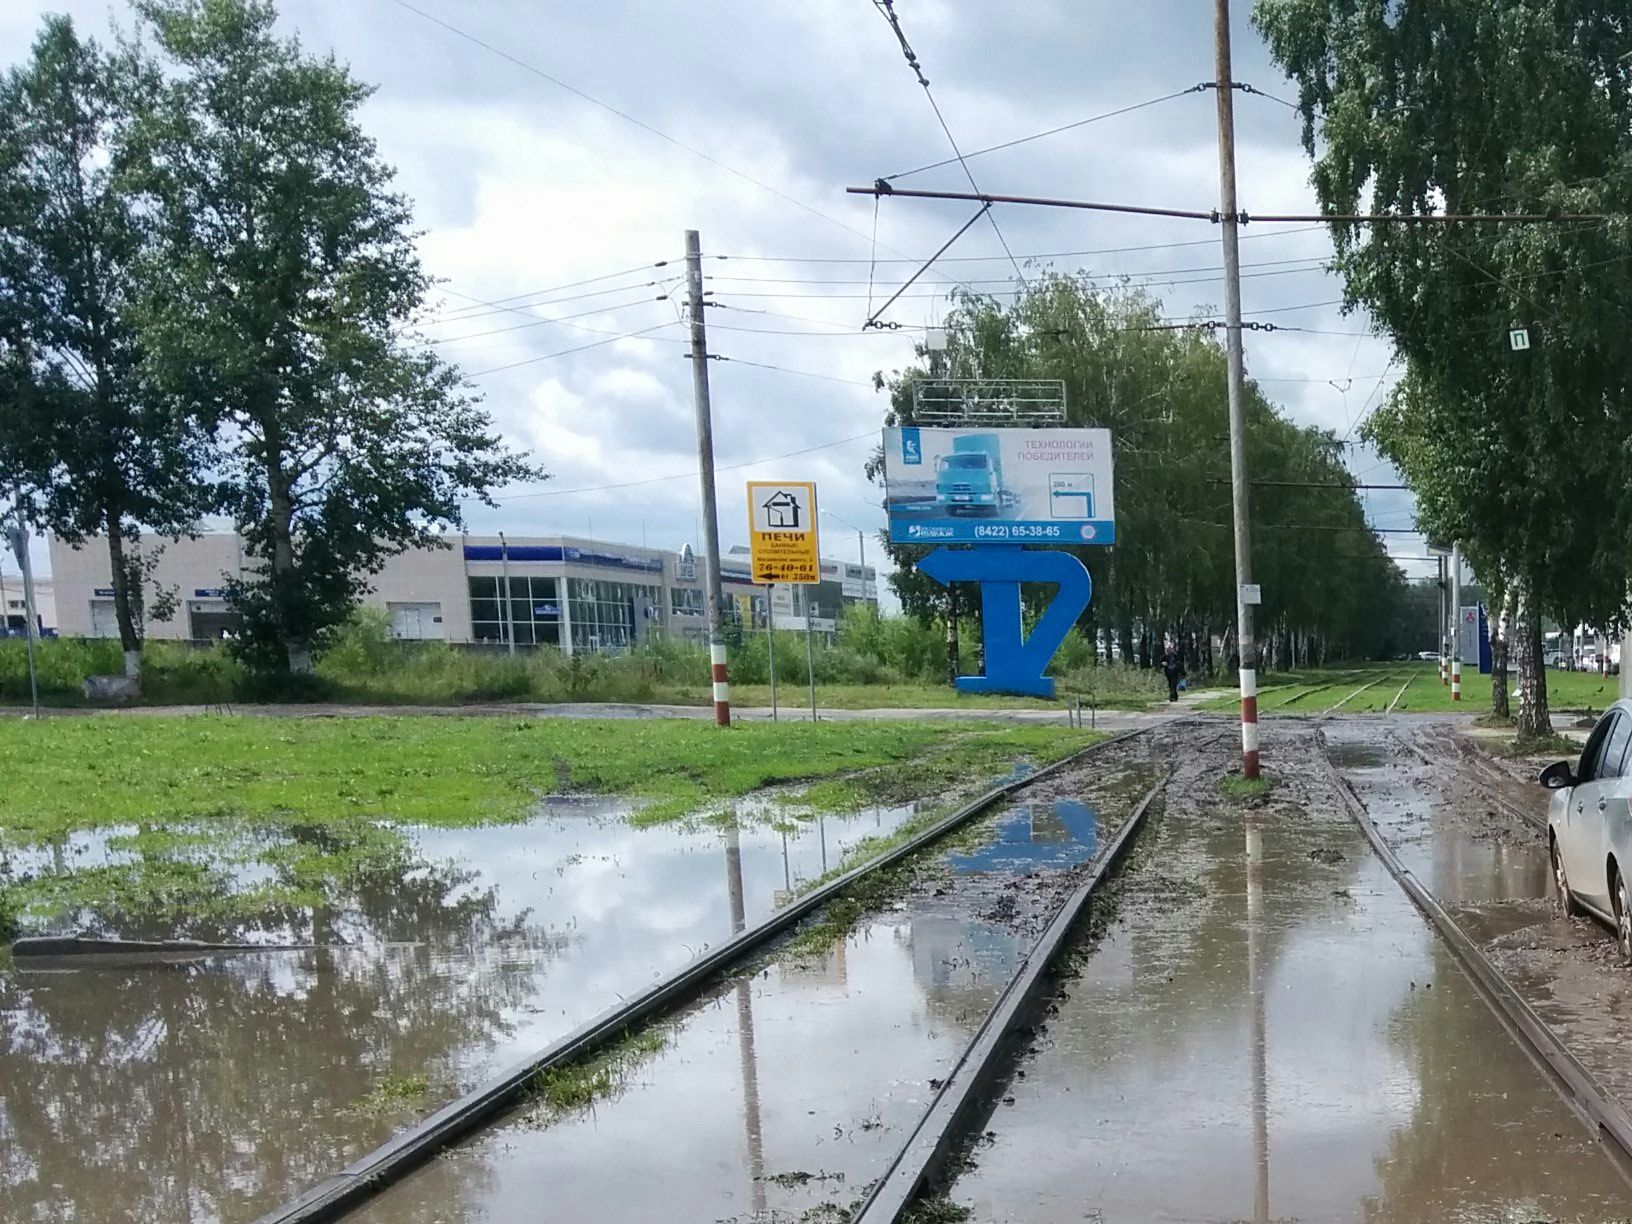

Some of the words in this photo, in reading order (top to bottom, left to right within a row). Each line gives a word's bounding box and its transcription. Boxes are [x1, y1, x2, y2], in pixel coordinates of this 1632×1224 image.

[1513, 332, 1526, 347] П
[1025, 440, 1093, 449] ТЕХНОЛОГИИ
[1018, 450, 1094, 461] ПОБЕДИТЕЛЕЙ
[762, 532, 805, 542] ПЕЧИ
[974, 525, 1009, 538] (8422)
[1012, 525, 1060, 537] 65-38-65
